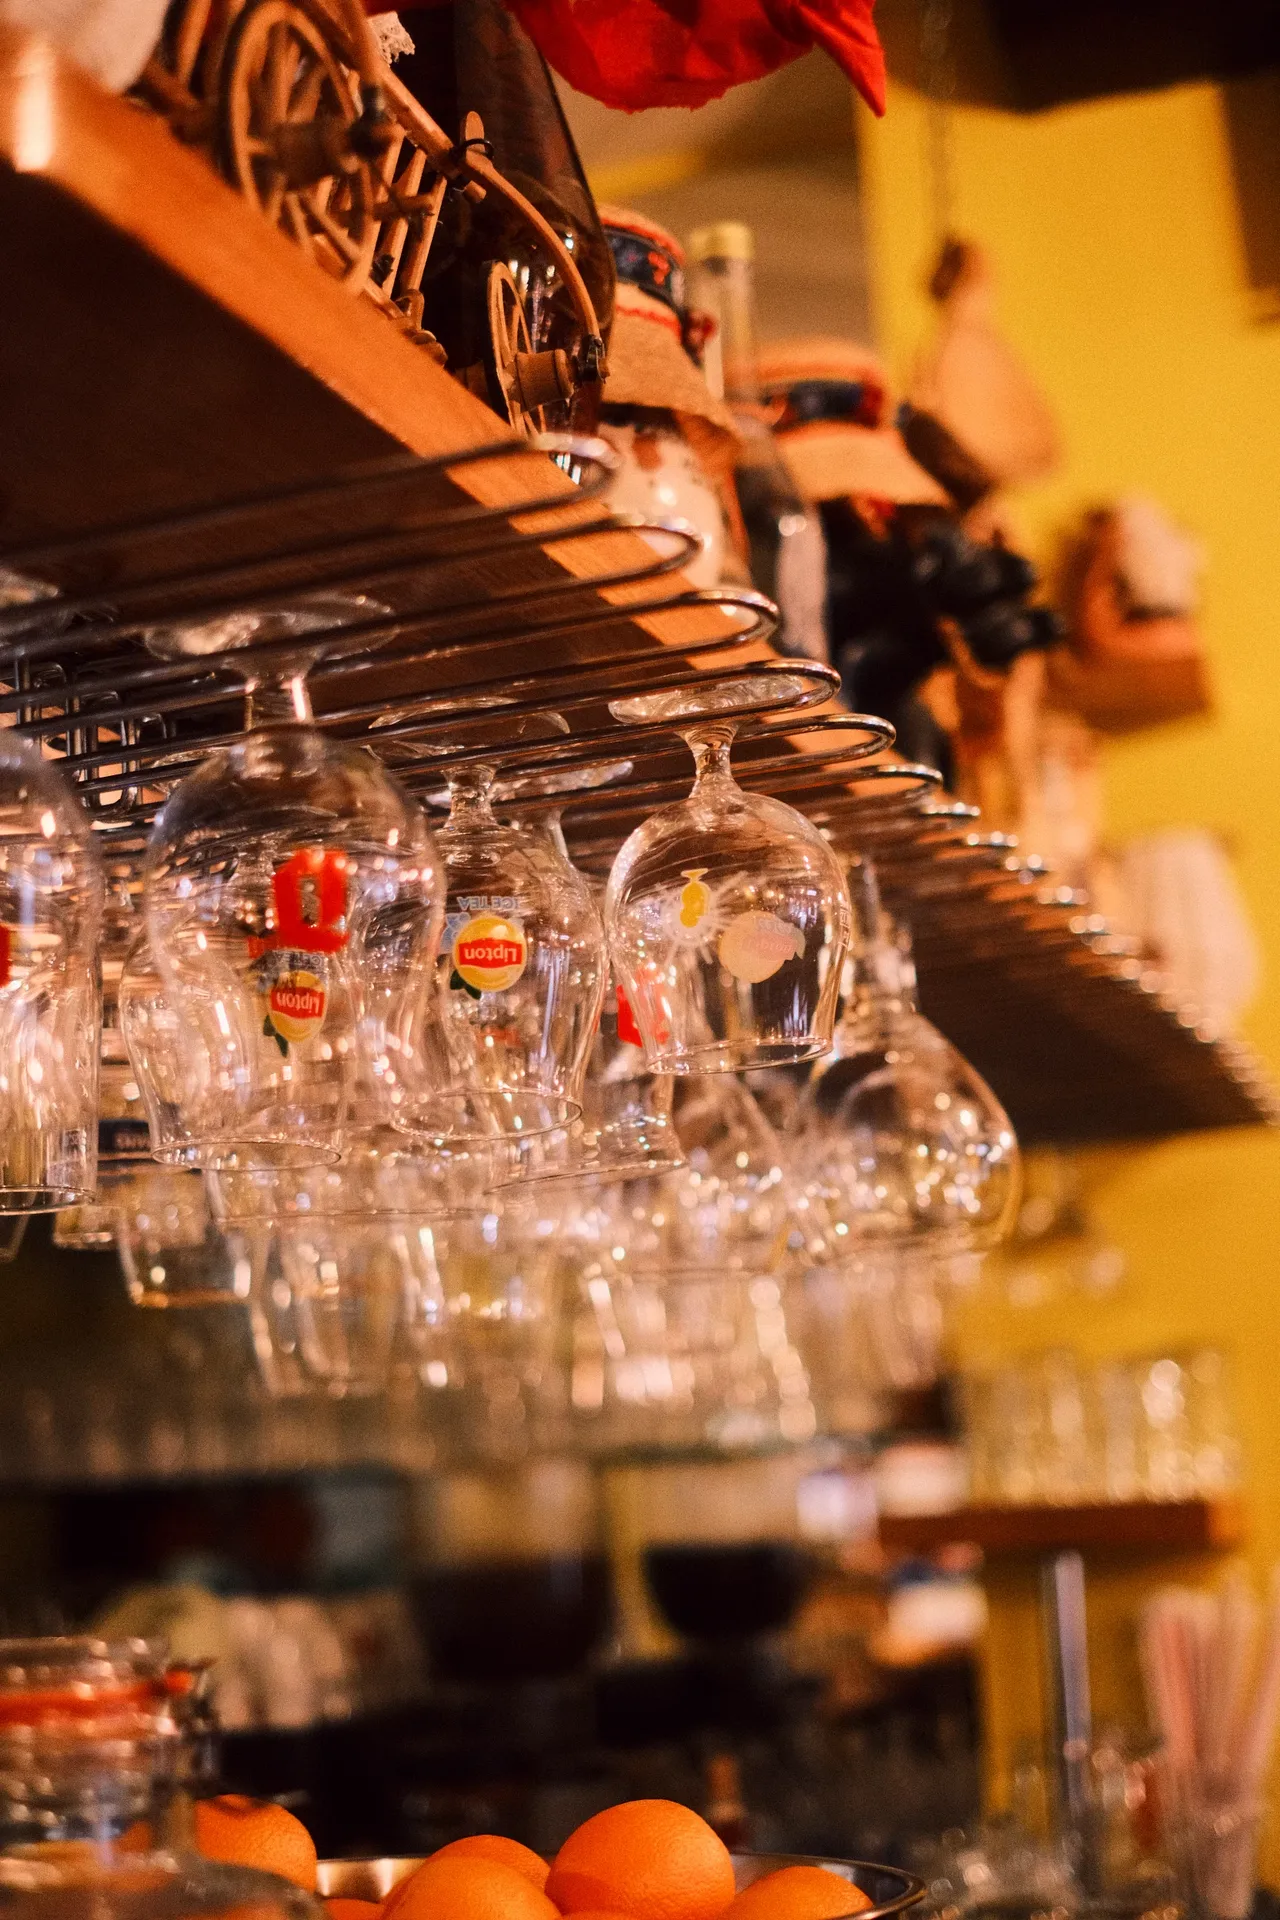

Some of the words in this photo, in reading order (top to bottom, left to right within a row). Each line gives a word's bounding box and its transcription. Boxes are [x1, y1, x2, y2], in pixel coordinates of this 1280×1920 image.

[457, 895, 491, 910] TEA
[464, 944, 517, 962] Lipton
[276, 992, 320, 1014] Lipton
